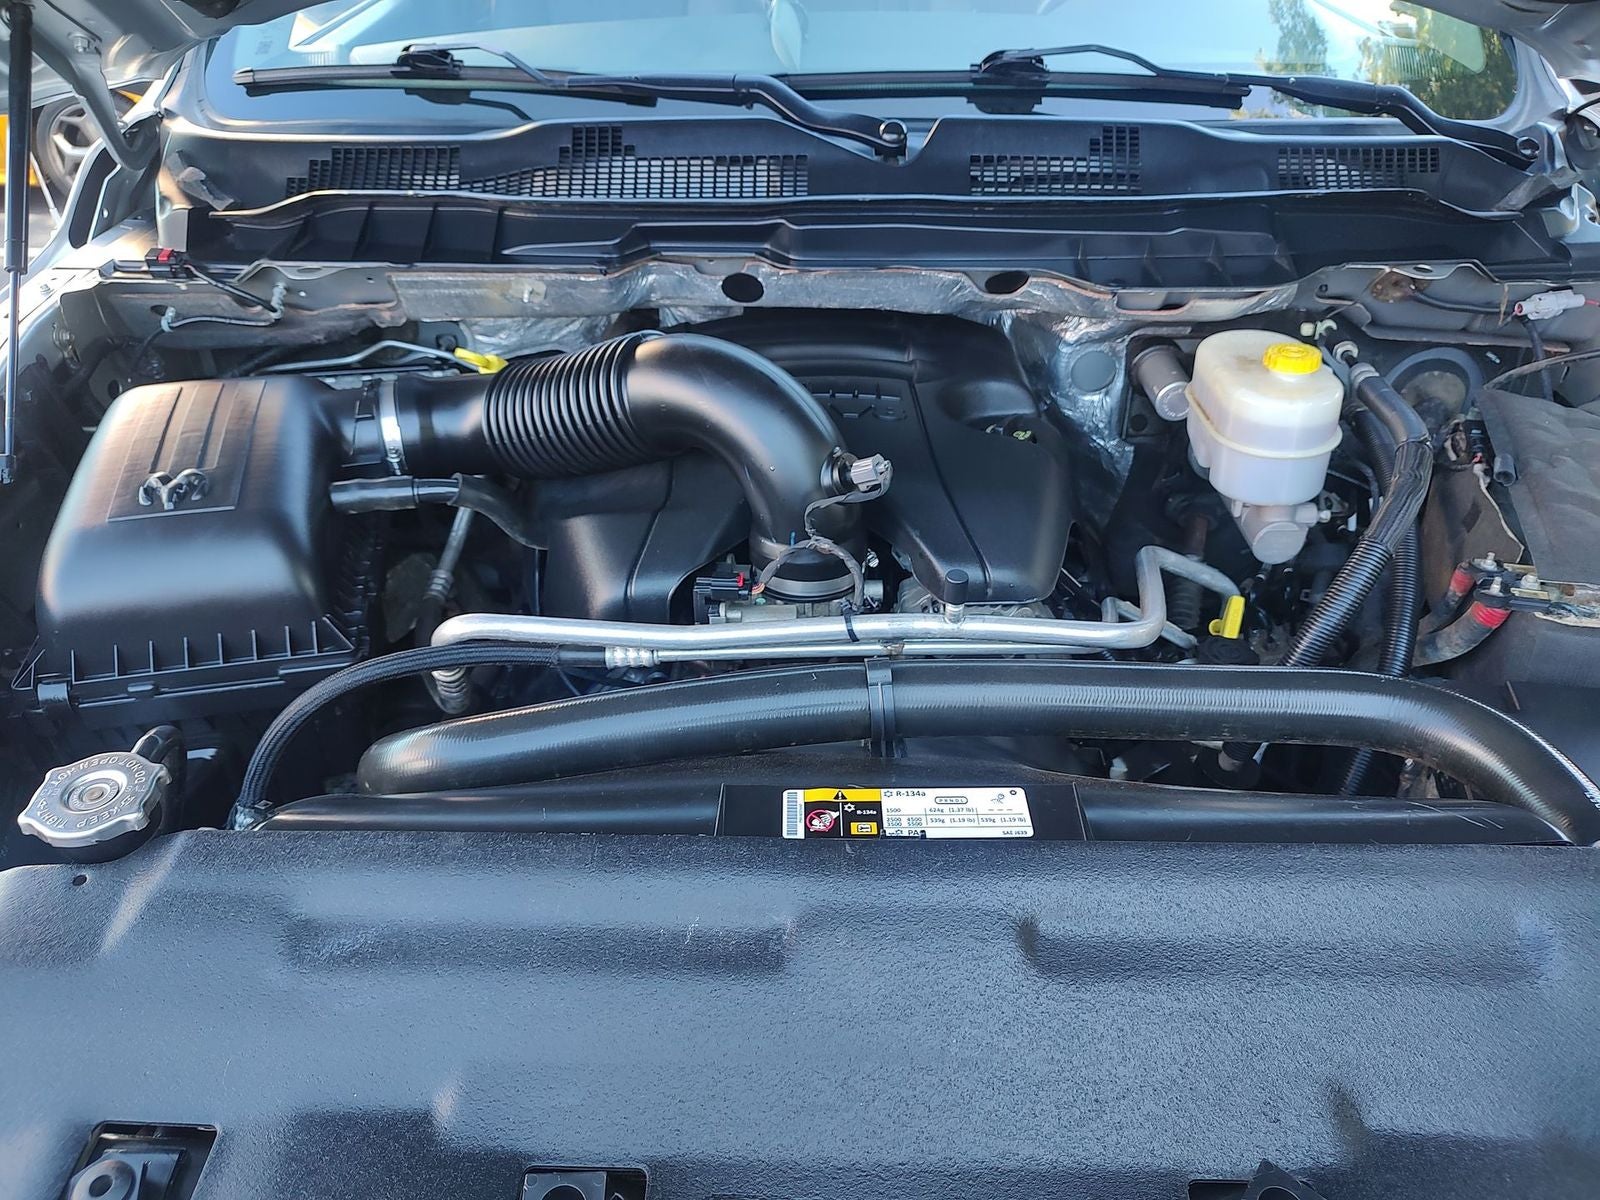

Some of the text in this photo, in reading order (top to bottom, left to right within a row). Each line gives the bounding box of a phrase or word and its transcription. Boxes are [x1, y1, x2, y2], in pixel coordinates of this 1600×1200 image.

[79, 756, 118, 769] OPEN
[119, 757, 143, 772] NOT
[37, 807, 121, 828] KEEP TIGHT
